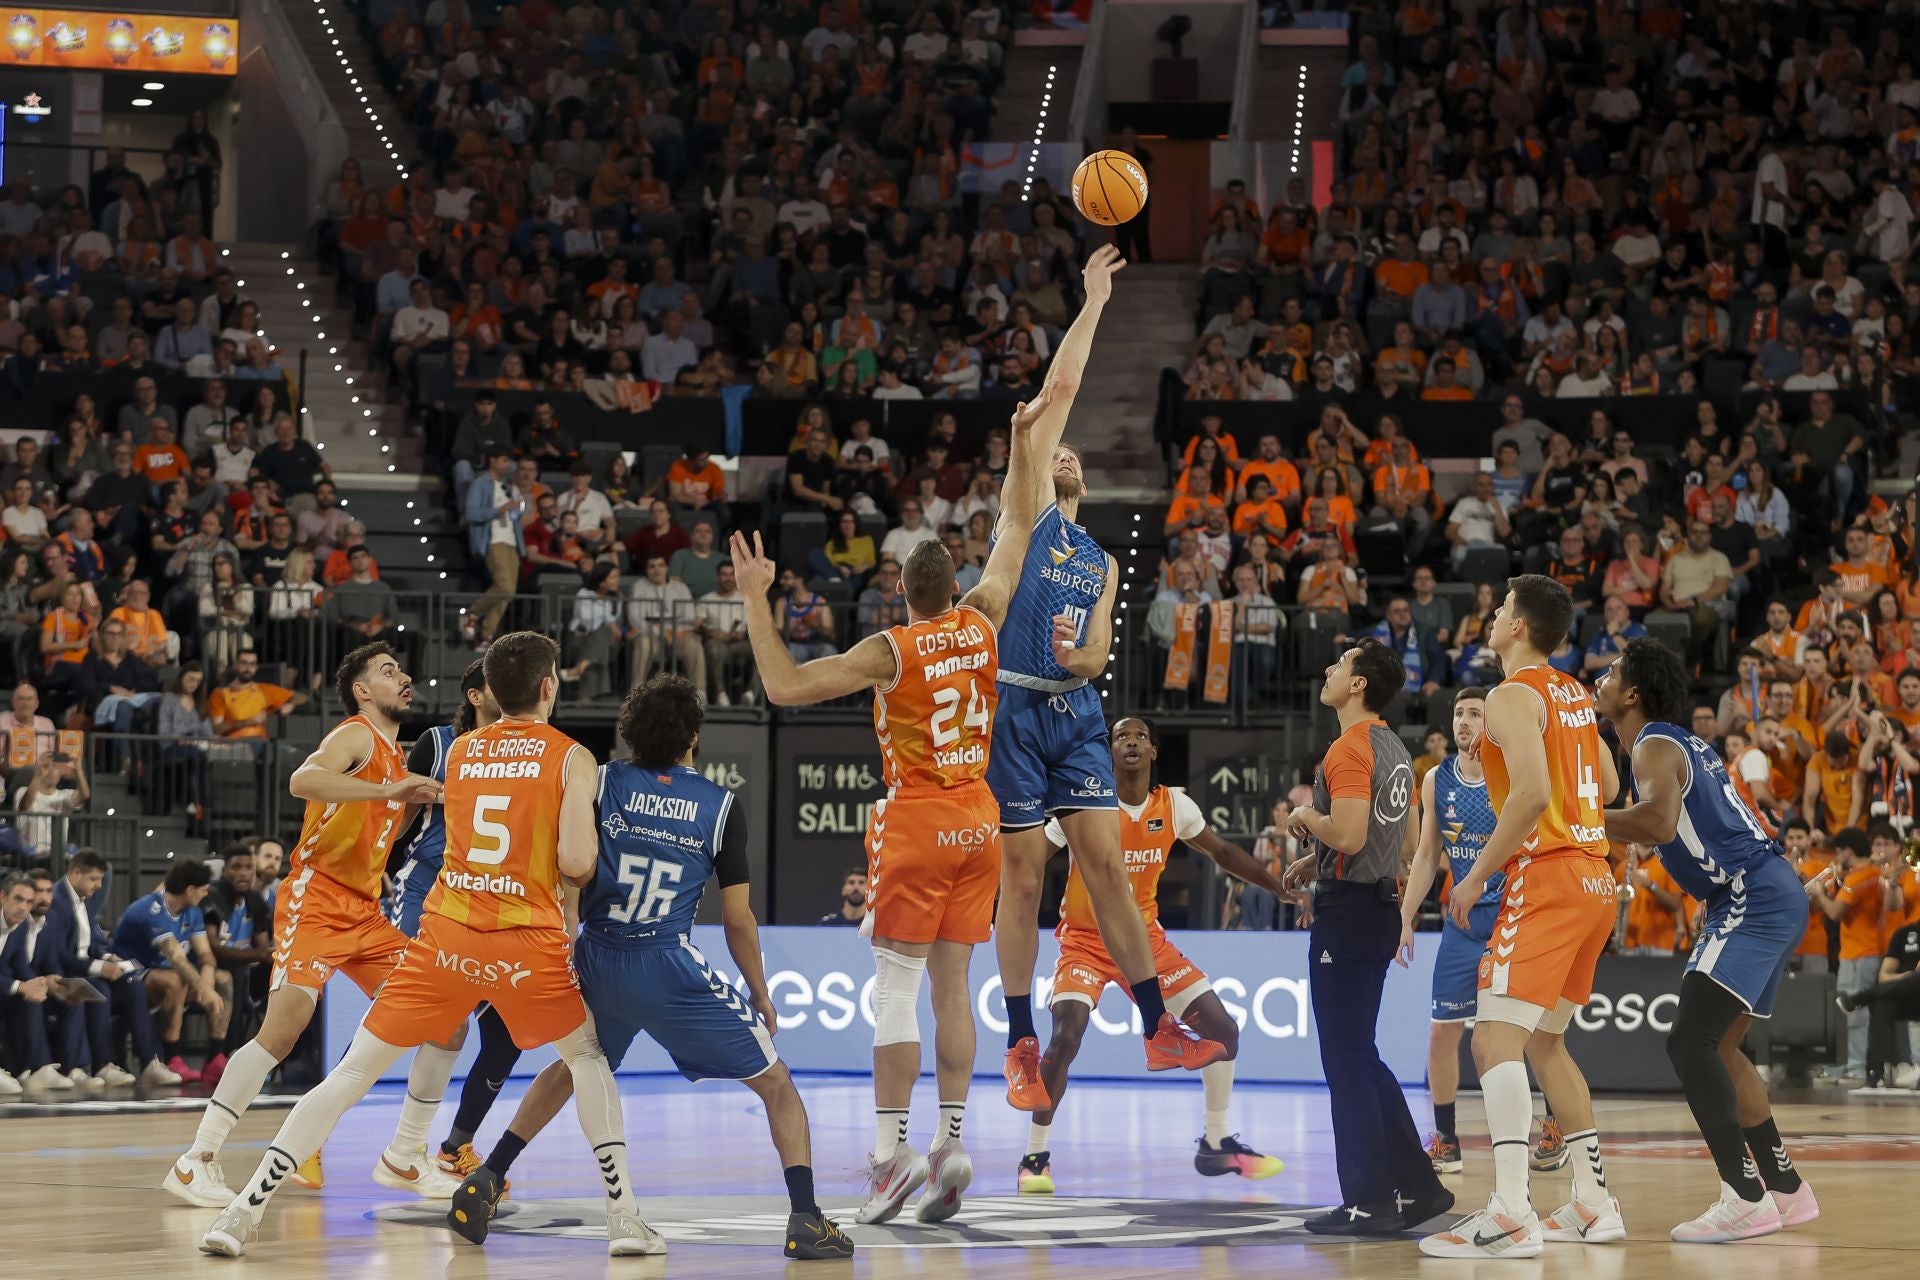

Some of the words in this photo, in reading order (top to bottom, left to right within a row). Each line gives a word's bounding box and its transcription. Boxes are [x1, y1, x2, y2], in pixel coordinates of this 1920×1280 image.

[924, 650, 990, 682] PAMESA
[929, 678, 990, 748] 24
[466, 738, 487, 758] DE
[488, 738, 547, 758] LARREA
[459, 760, 541, 781] PAMESA
[1577, 743, 1599, 810] 4
[624, 791, 699, 823] JACKSON
[1070, 788, 1114, 798] LEXUS
[1389, 776, 1408, 809] 66
[376, 818, 393, 849] 2
[466, 794, 512, 865] 5
[631, 825, 677, 843] recoletas
[678, 834, 704, 849] salud
[936, 828, 985, 848] MGS
[445, 871, 526, 898] Vitaldin
[607, 852, 685, 924] 56
[435, 949, 500, 982] MGS
[1163, 964, 1193, 988] Midea
